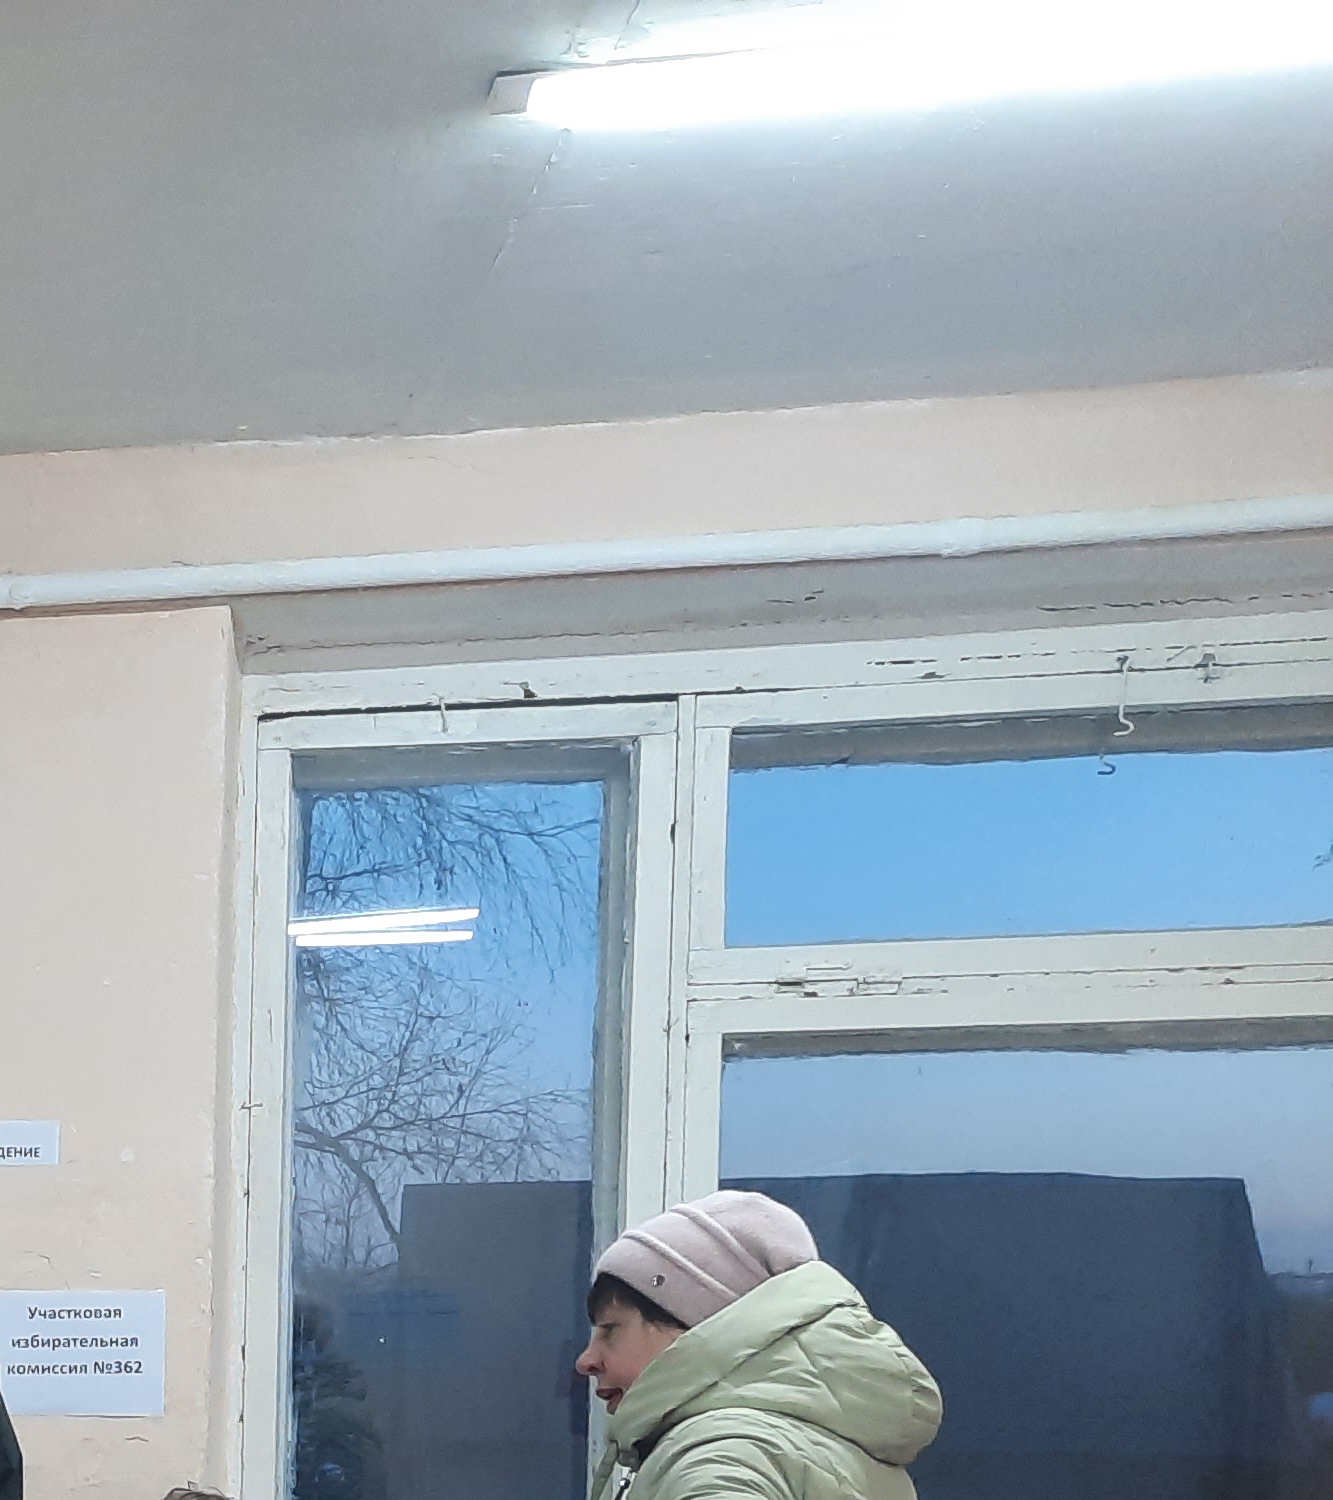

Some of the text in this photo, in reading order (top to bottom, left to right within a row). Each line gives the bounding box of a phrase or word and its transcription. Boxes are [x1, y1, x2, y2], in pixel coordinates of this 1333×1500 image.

[27, 1306, 122, 1320] Участковая
[11, 1335, 139, 1351] избирательная
[7, 1360, 143, 1375] комиссия №362
